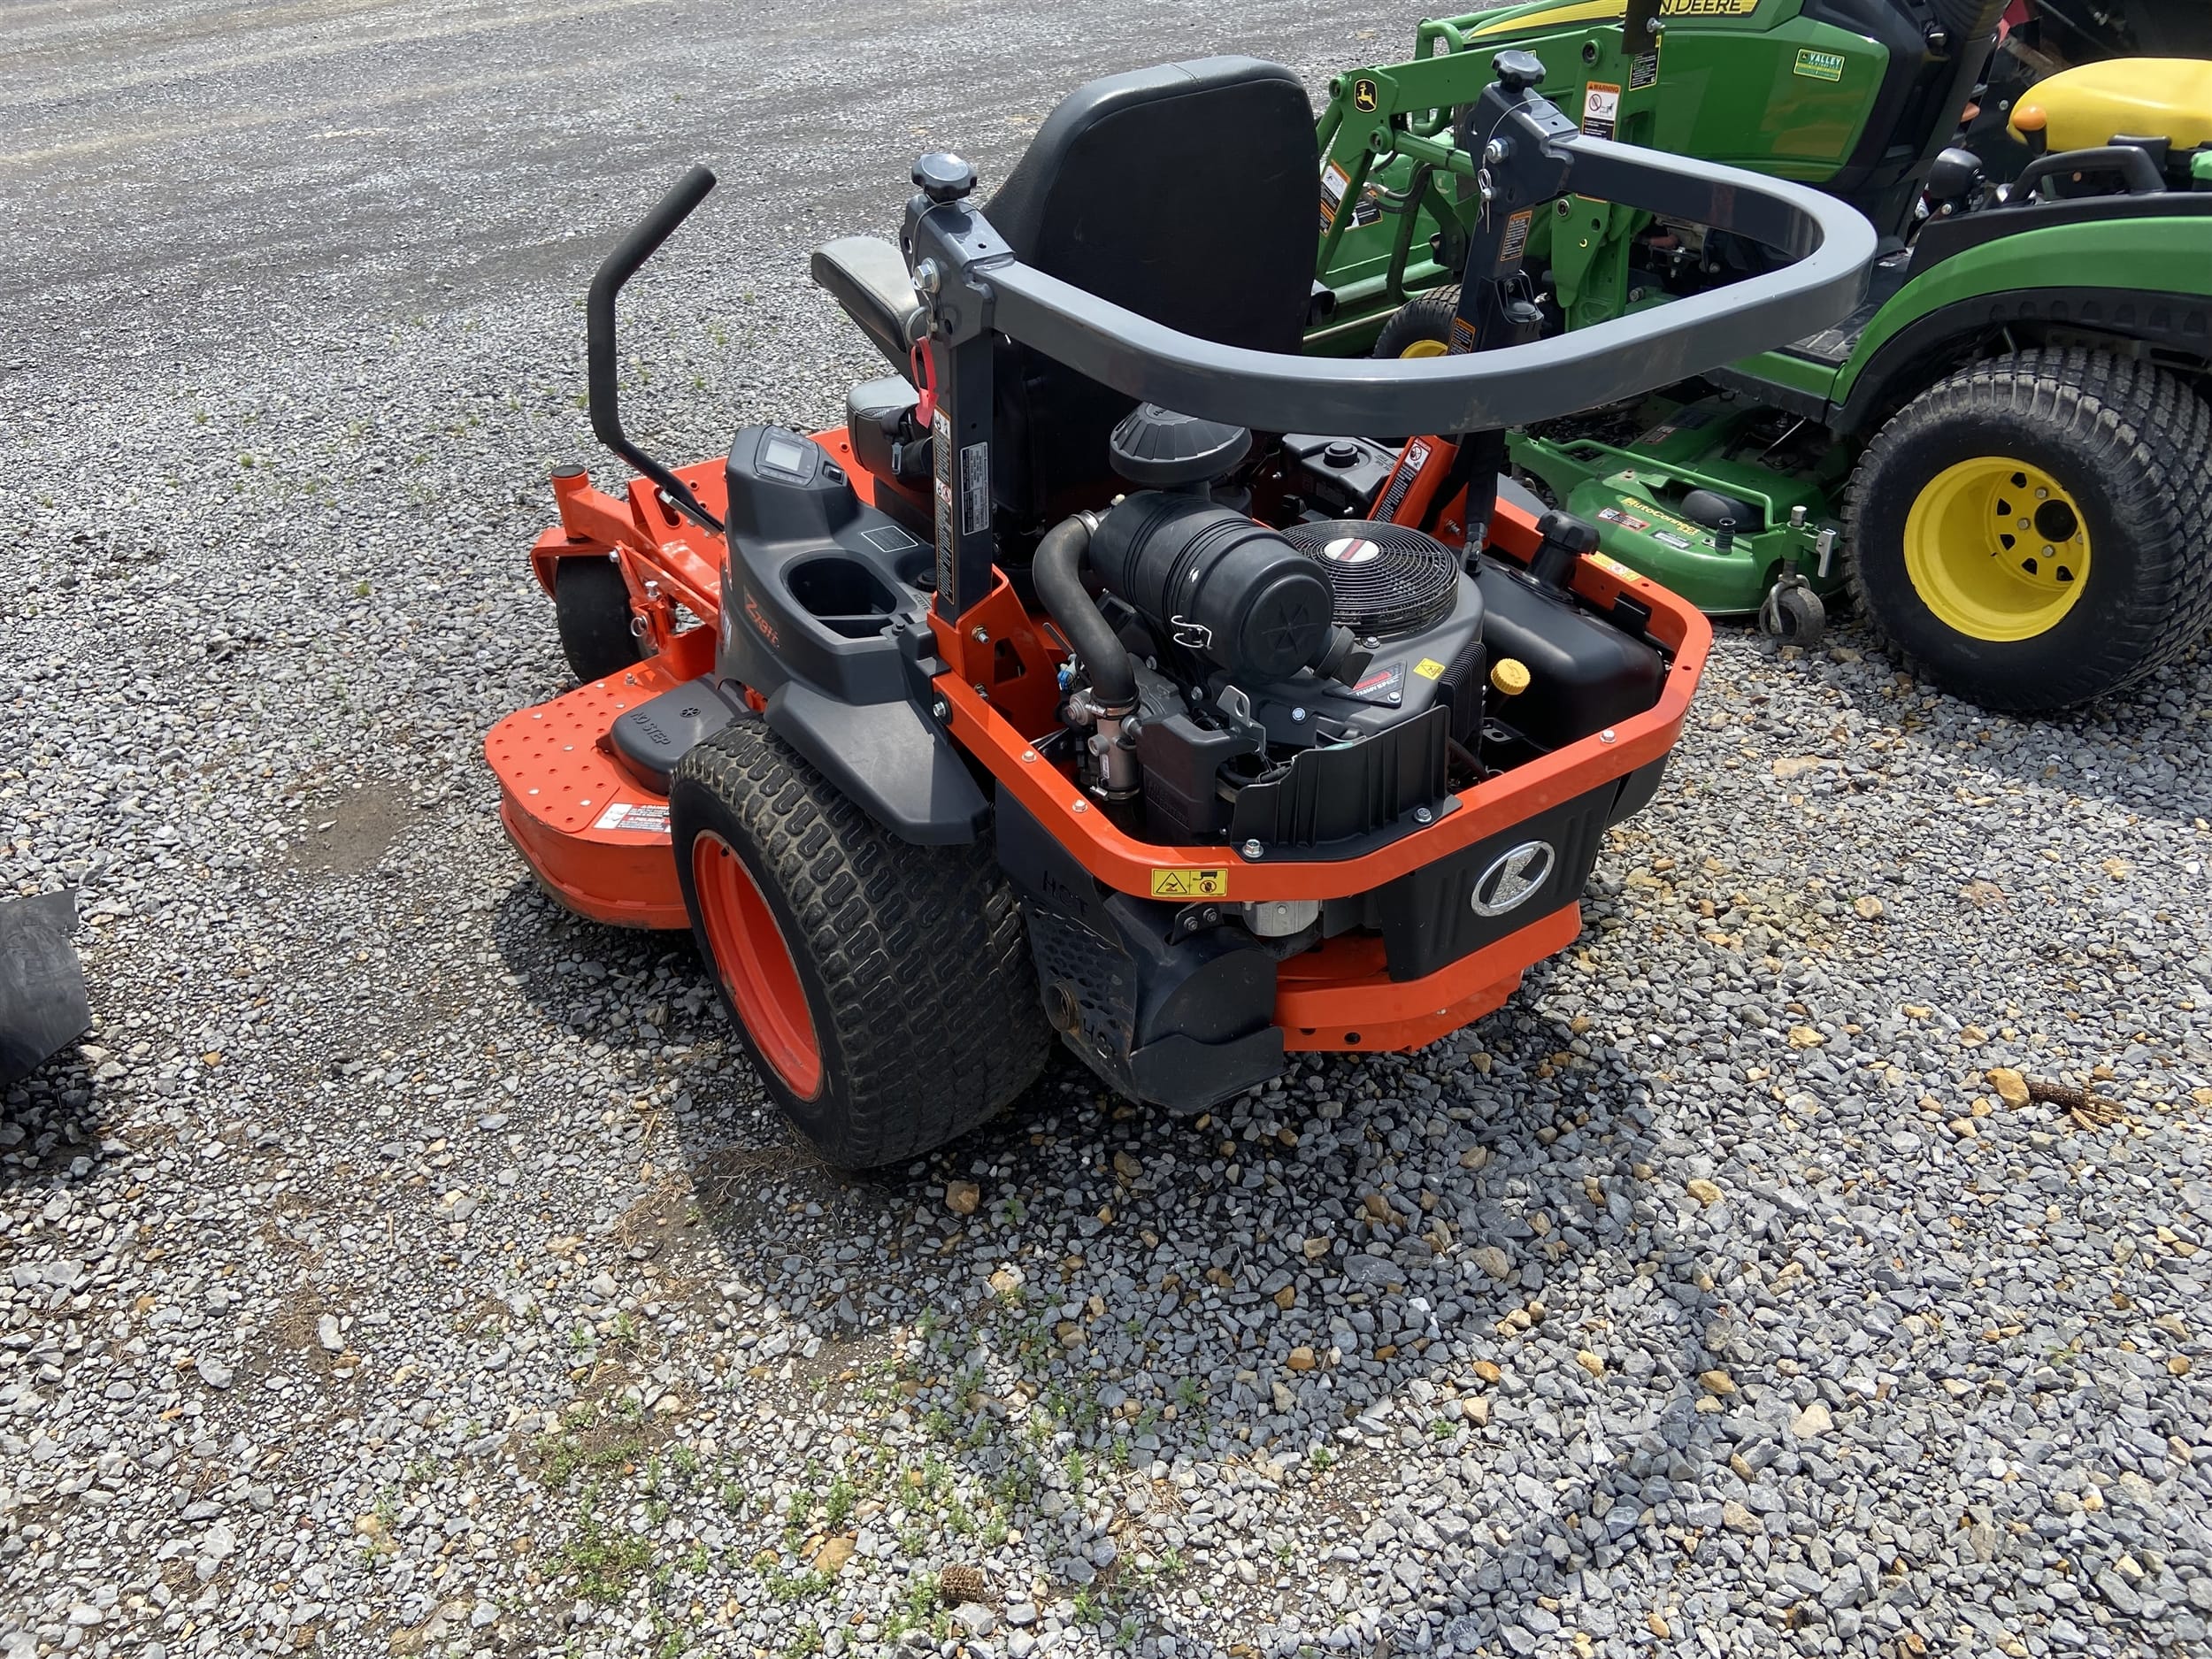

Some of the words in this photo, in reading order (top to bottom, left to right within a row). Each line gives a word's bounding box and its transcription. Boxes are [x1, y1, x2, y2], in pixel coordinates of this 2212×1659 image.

[1675, 0, 1742, 12] DEERE
[1810, 53, 1841, 65] VALLEY
[630, 711, 651, 725] NO
[642, 723, 672, 745] STEP
[1042, 870, 1089, 917] HOT
